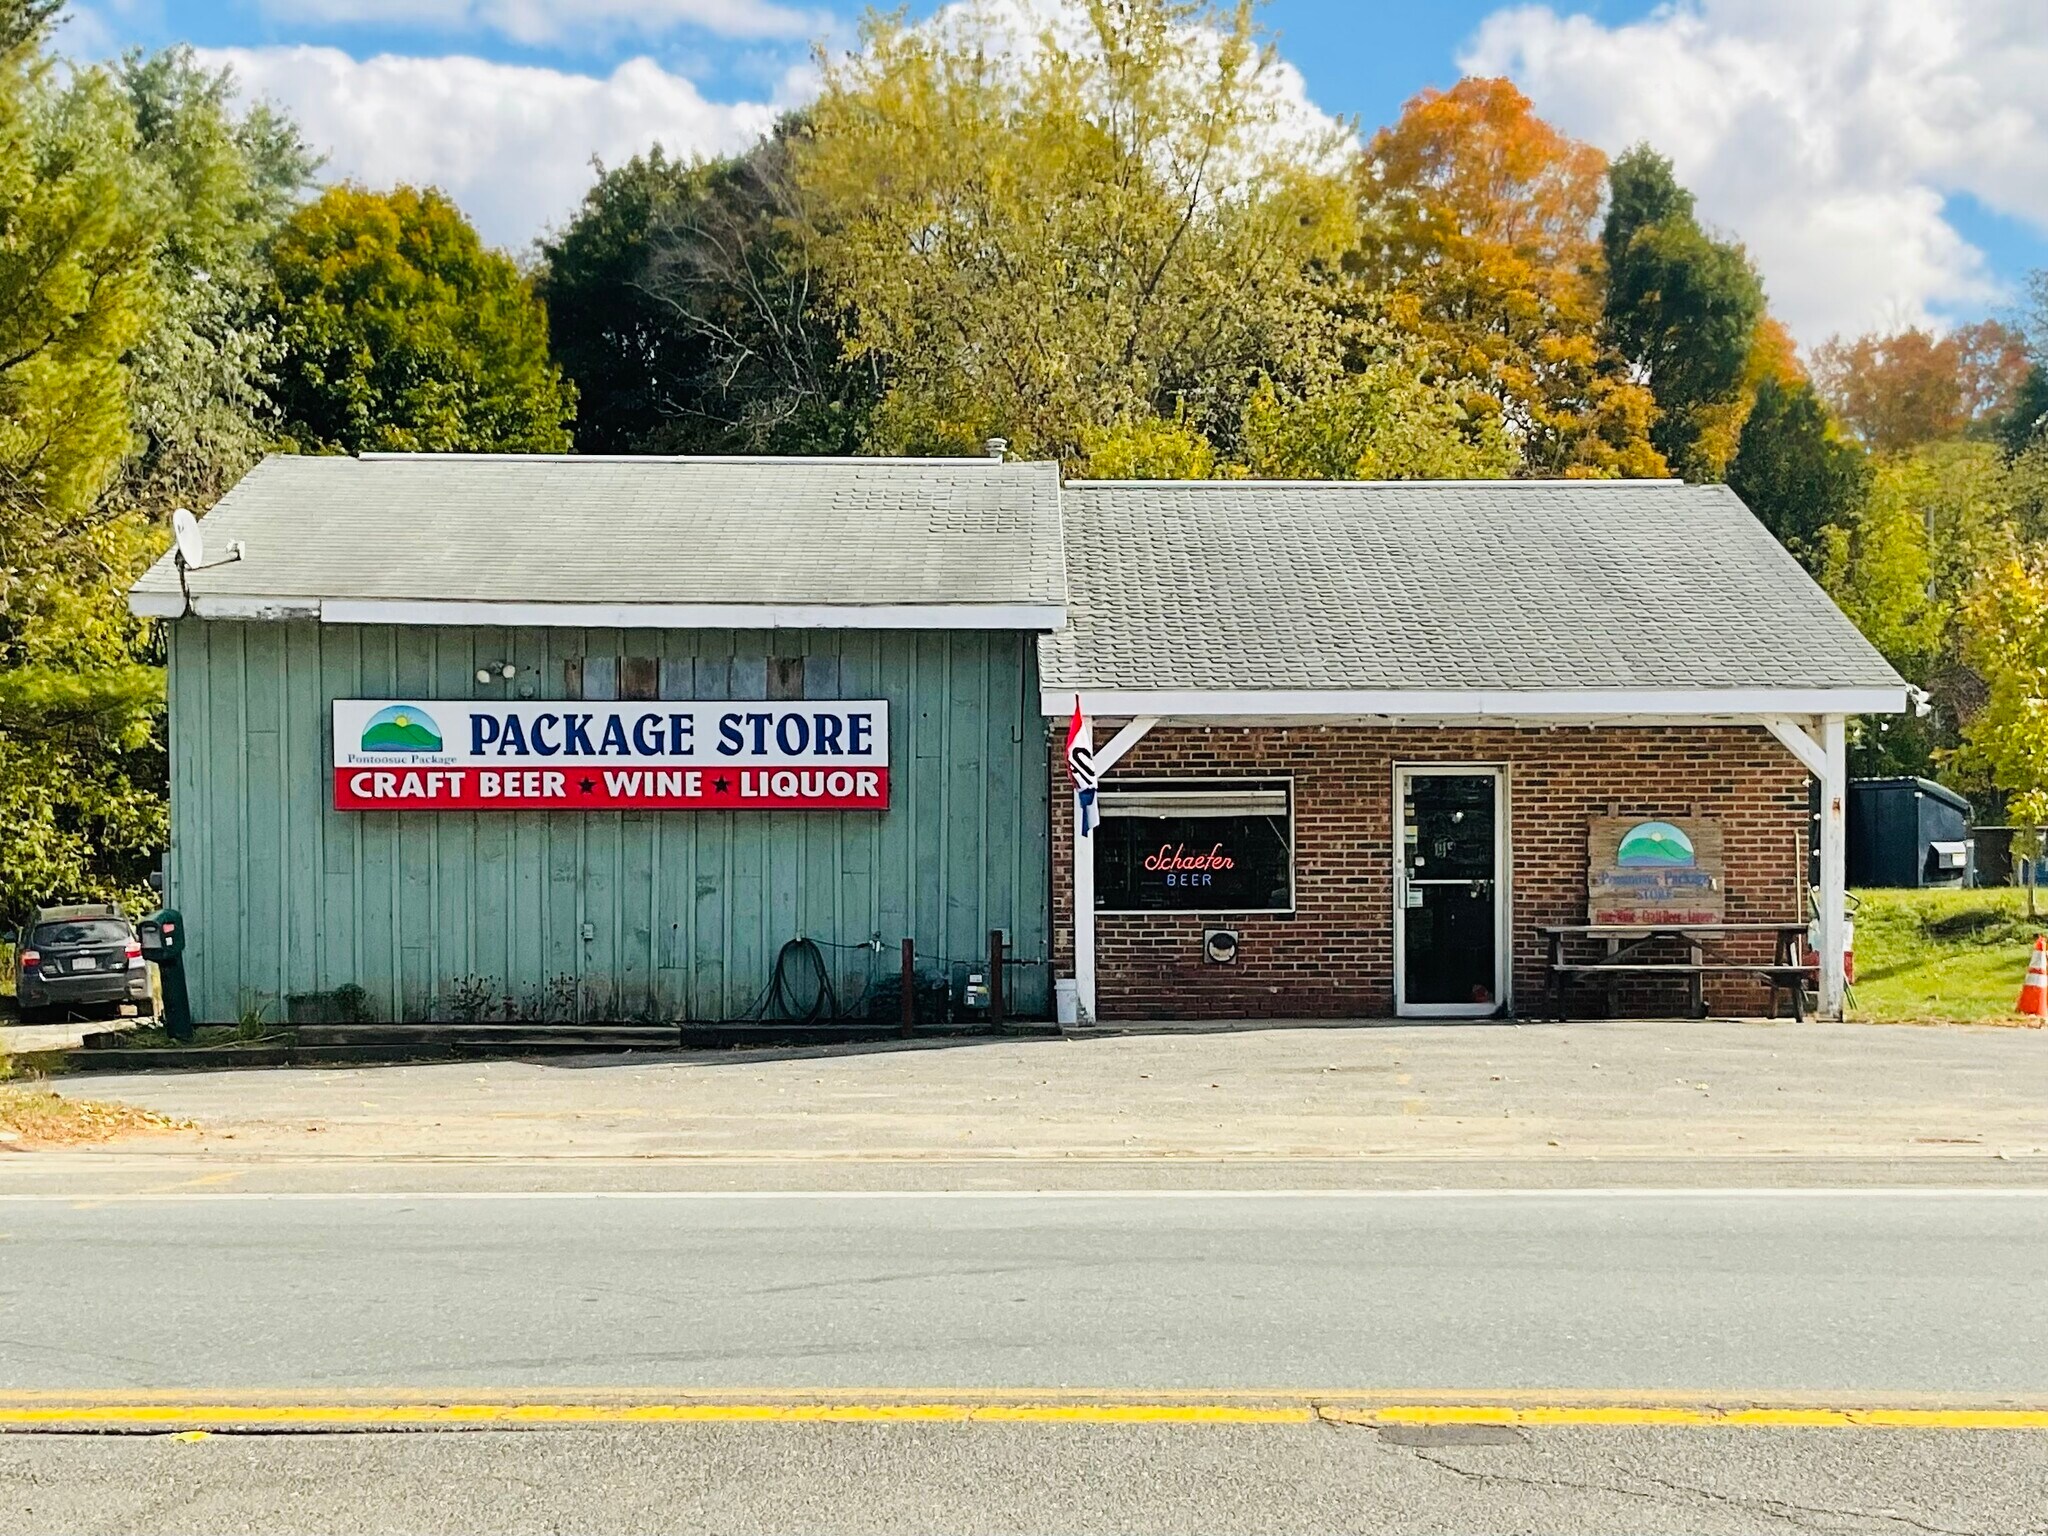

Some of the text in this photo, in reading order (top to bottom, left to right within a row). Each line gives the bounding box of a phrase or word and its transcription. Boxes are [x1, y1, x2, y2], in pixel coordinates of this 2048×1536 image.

[469, 713, 872, 756] PACKAGE STORE
[348, 753, 457, 766] Pontoosuc Package
[350, 771, 880, 798] CRAFT BEER WINE LIQUOR
[1144, 842, 1235, 871] Schaefer
[1166, 873, 1212, 887] BEER
